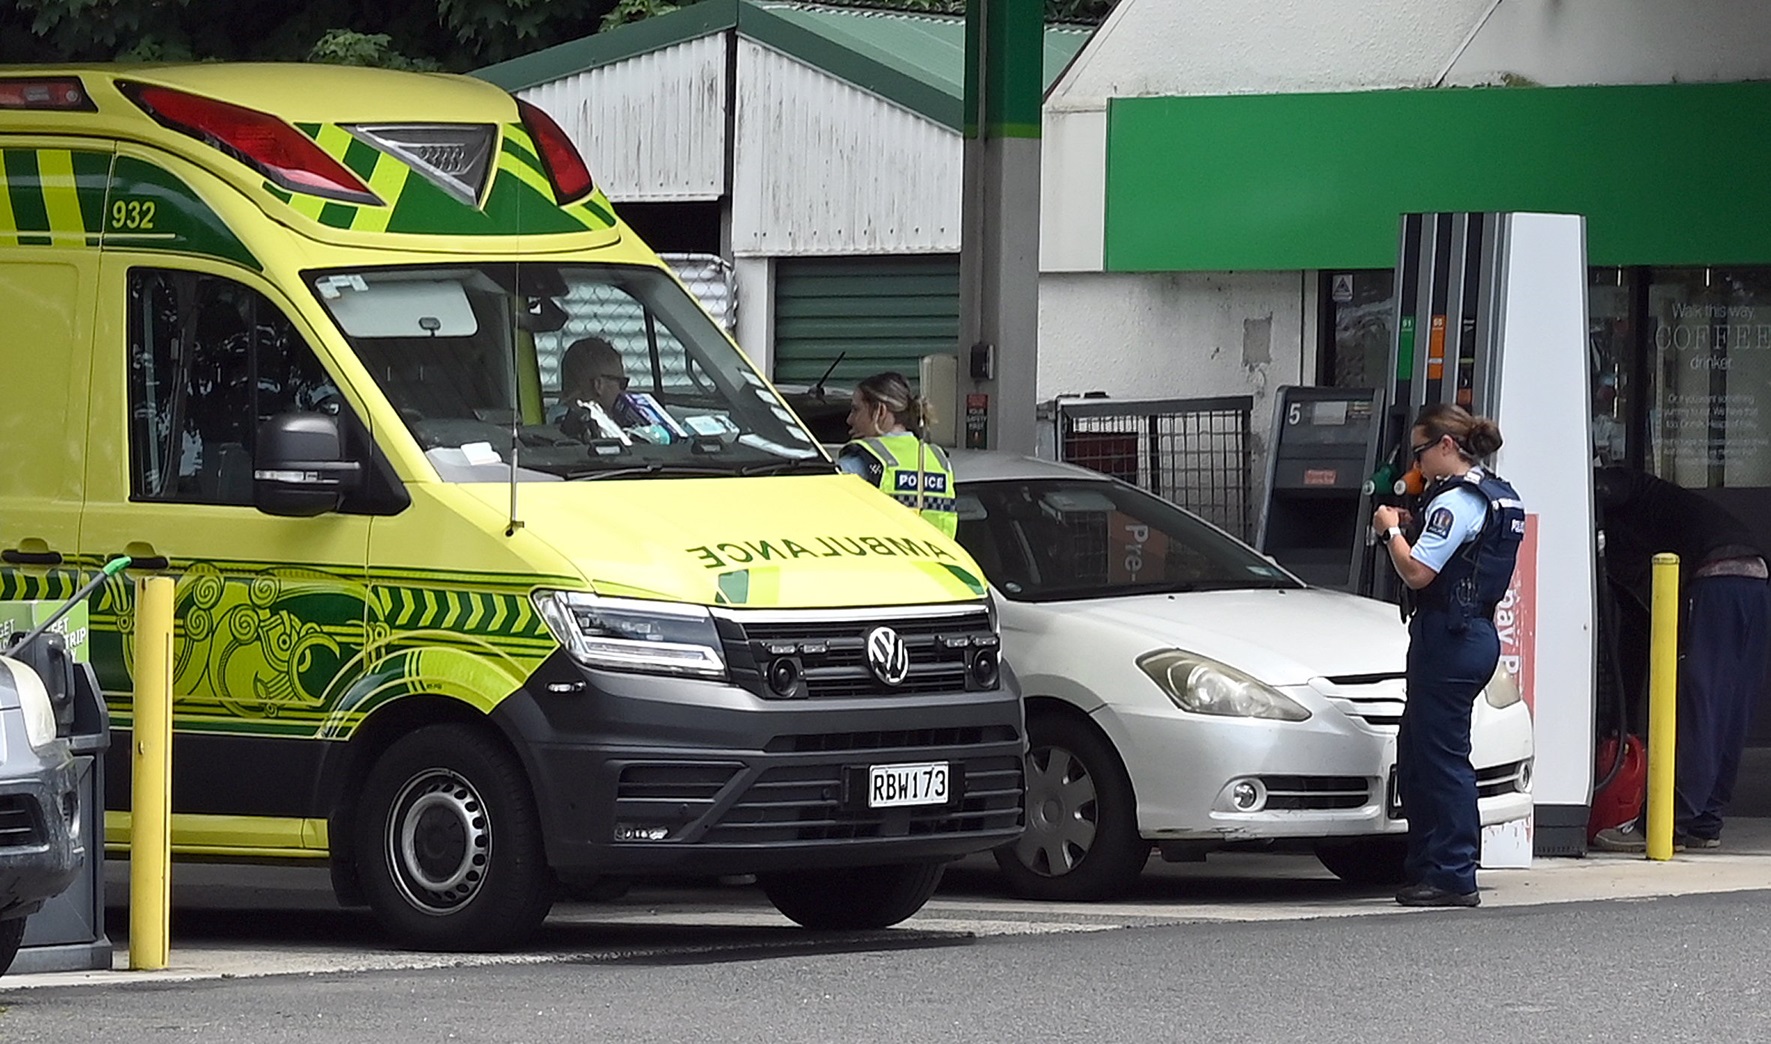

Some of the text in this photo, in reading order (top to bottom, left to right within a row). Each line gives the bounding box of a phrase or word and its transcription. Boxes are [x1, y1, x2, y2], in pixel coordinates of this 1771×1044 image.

[111, 200, 156, 229] 932
[1655, 324, 1771, 350] COFFEE
[1288, 403, 1301, 425] 5
[899, 474, 944, 489] POICE
[873, 769, 946, 801] RBW173
